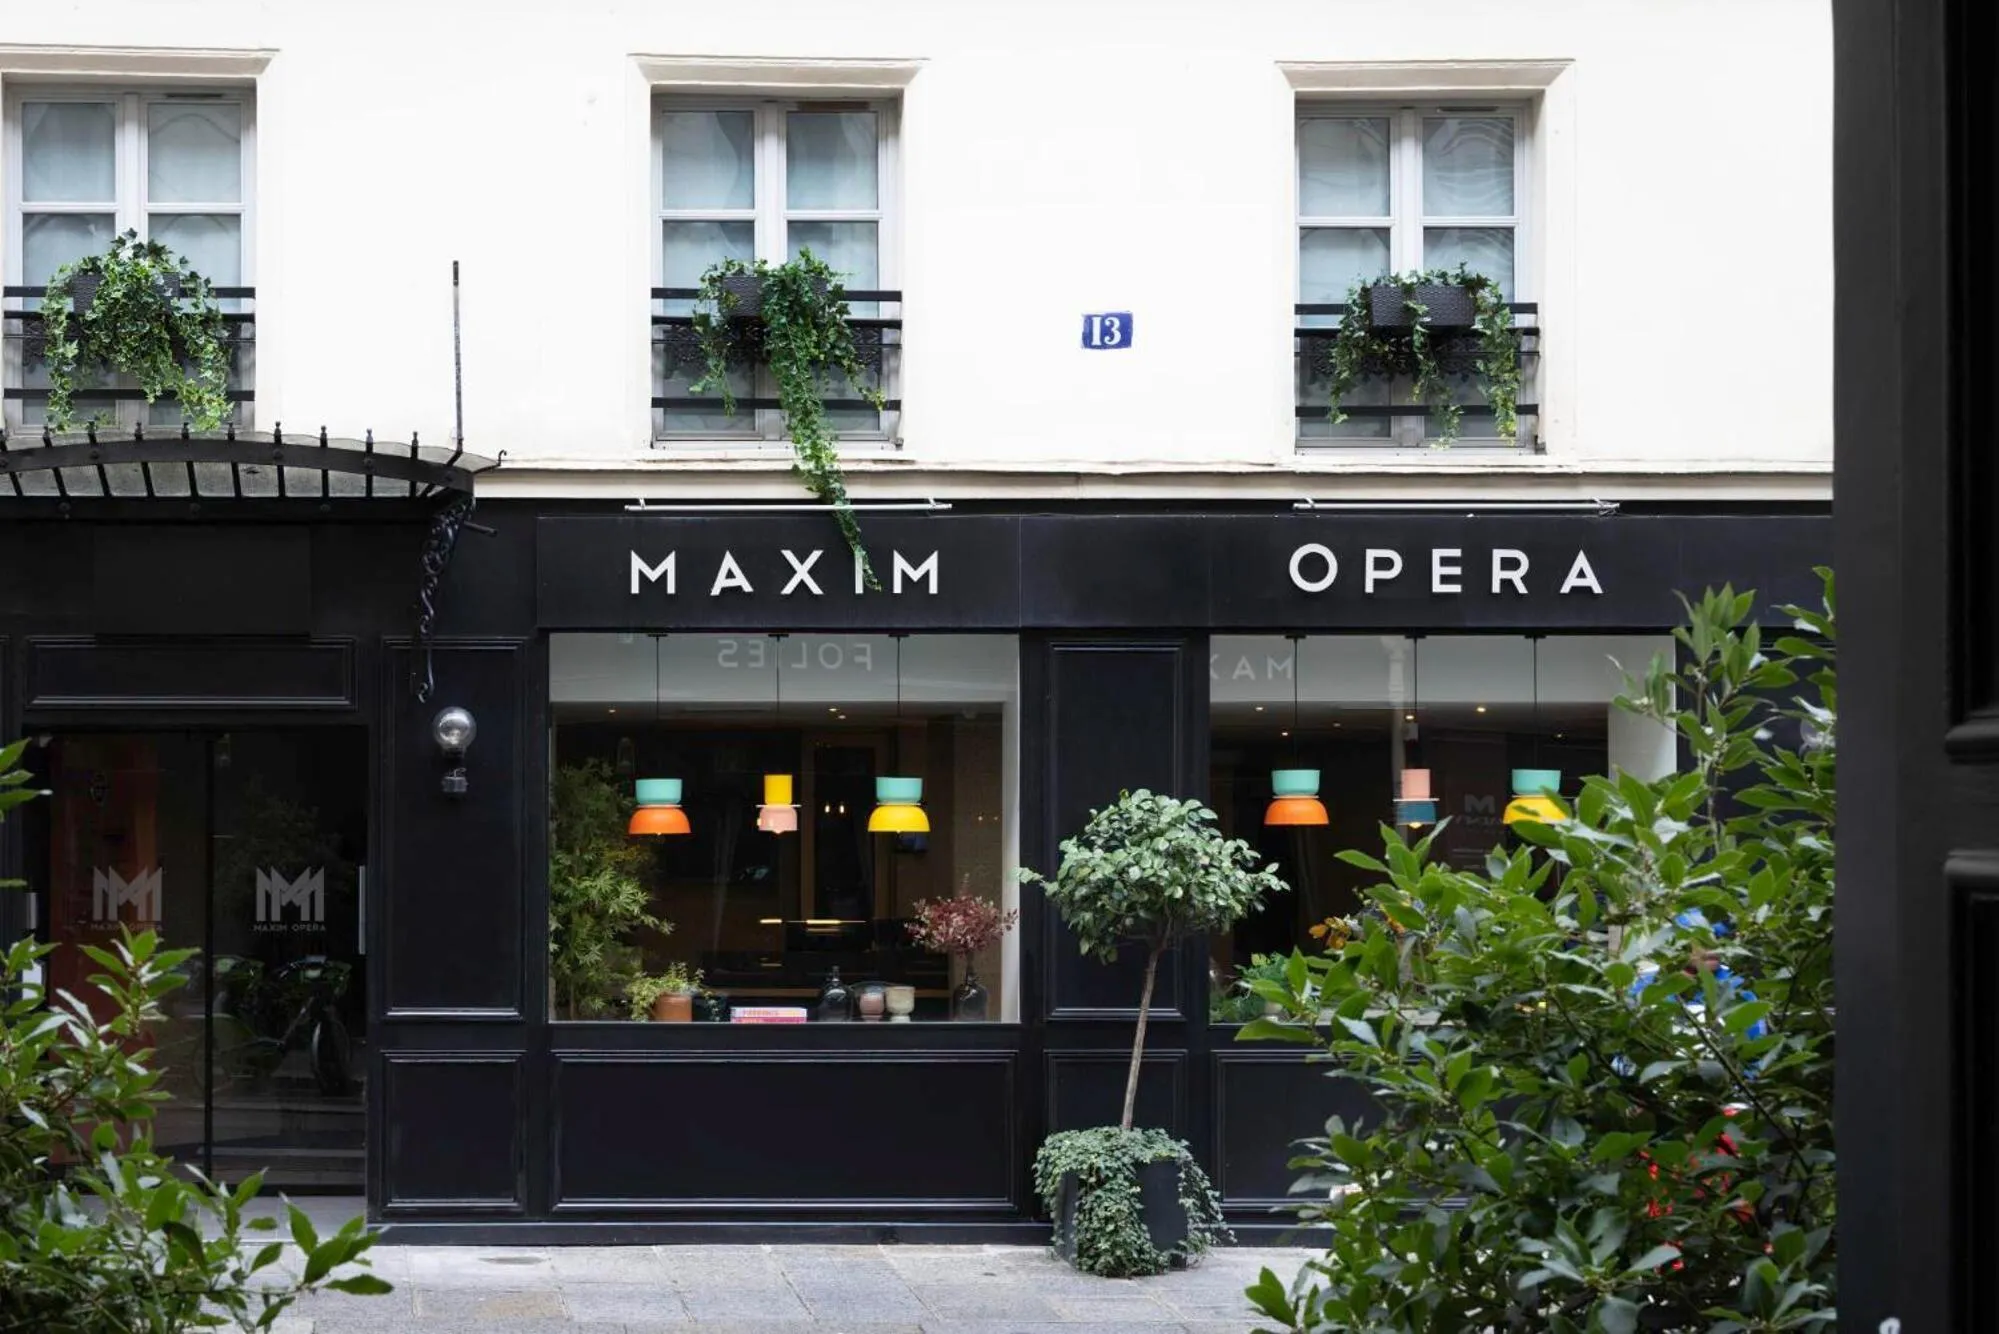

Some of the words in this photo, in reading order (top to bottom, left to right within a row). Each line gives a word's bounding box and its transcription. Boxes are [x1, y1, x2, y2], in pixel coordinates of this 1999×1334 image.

[1091, 316, 1122, 346] 13
[630, 549, 939, 596] MAXIM
[1289, 543, 1604, 594] OPERA
[253, 923, 288, 932] MAXIM
[291, 923, 327, 932] OPERA
